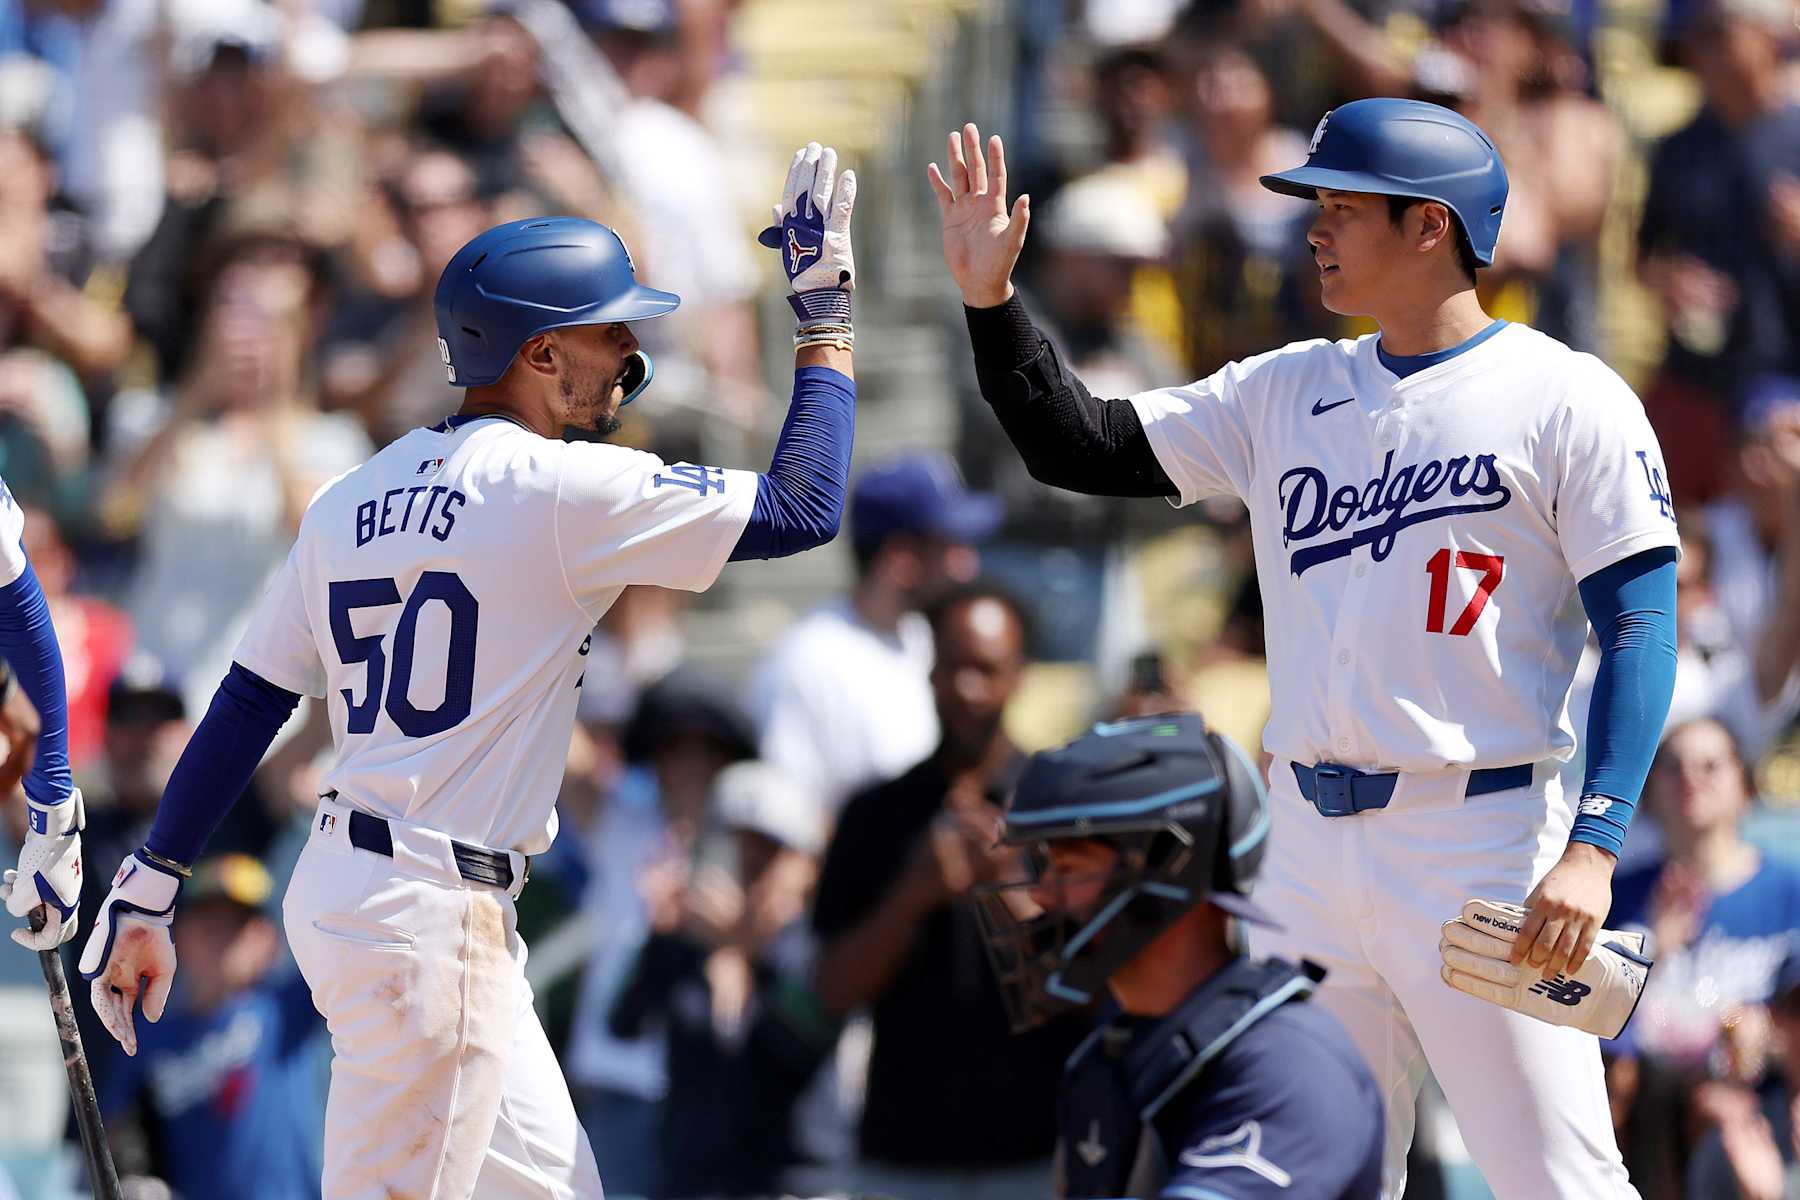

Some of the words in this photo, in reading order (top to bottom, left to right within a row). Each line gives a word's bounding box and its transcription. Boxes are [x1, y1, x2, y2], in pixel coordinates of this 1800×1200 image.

[356, 485, 466, 548] BETTS
[653, 464, 725, 497] LA
[1279, 449, 1510, 572] Dodgers
[1425, 548, 1504, 637] 17
[328, 570, 479, 738] 50
[1472, 913, 1492, 925] new
[1492, 917, 1521, 935] balanc
